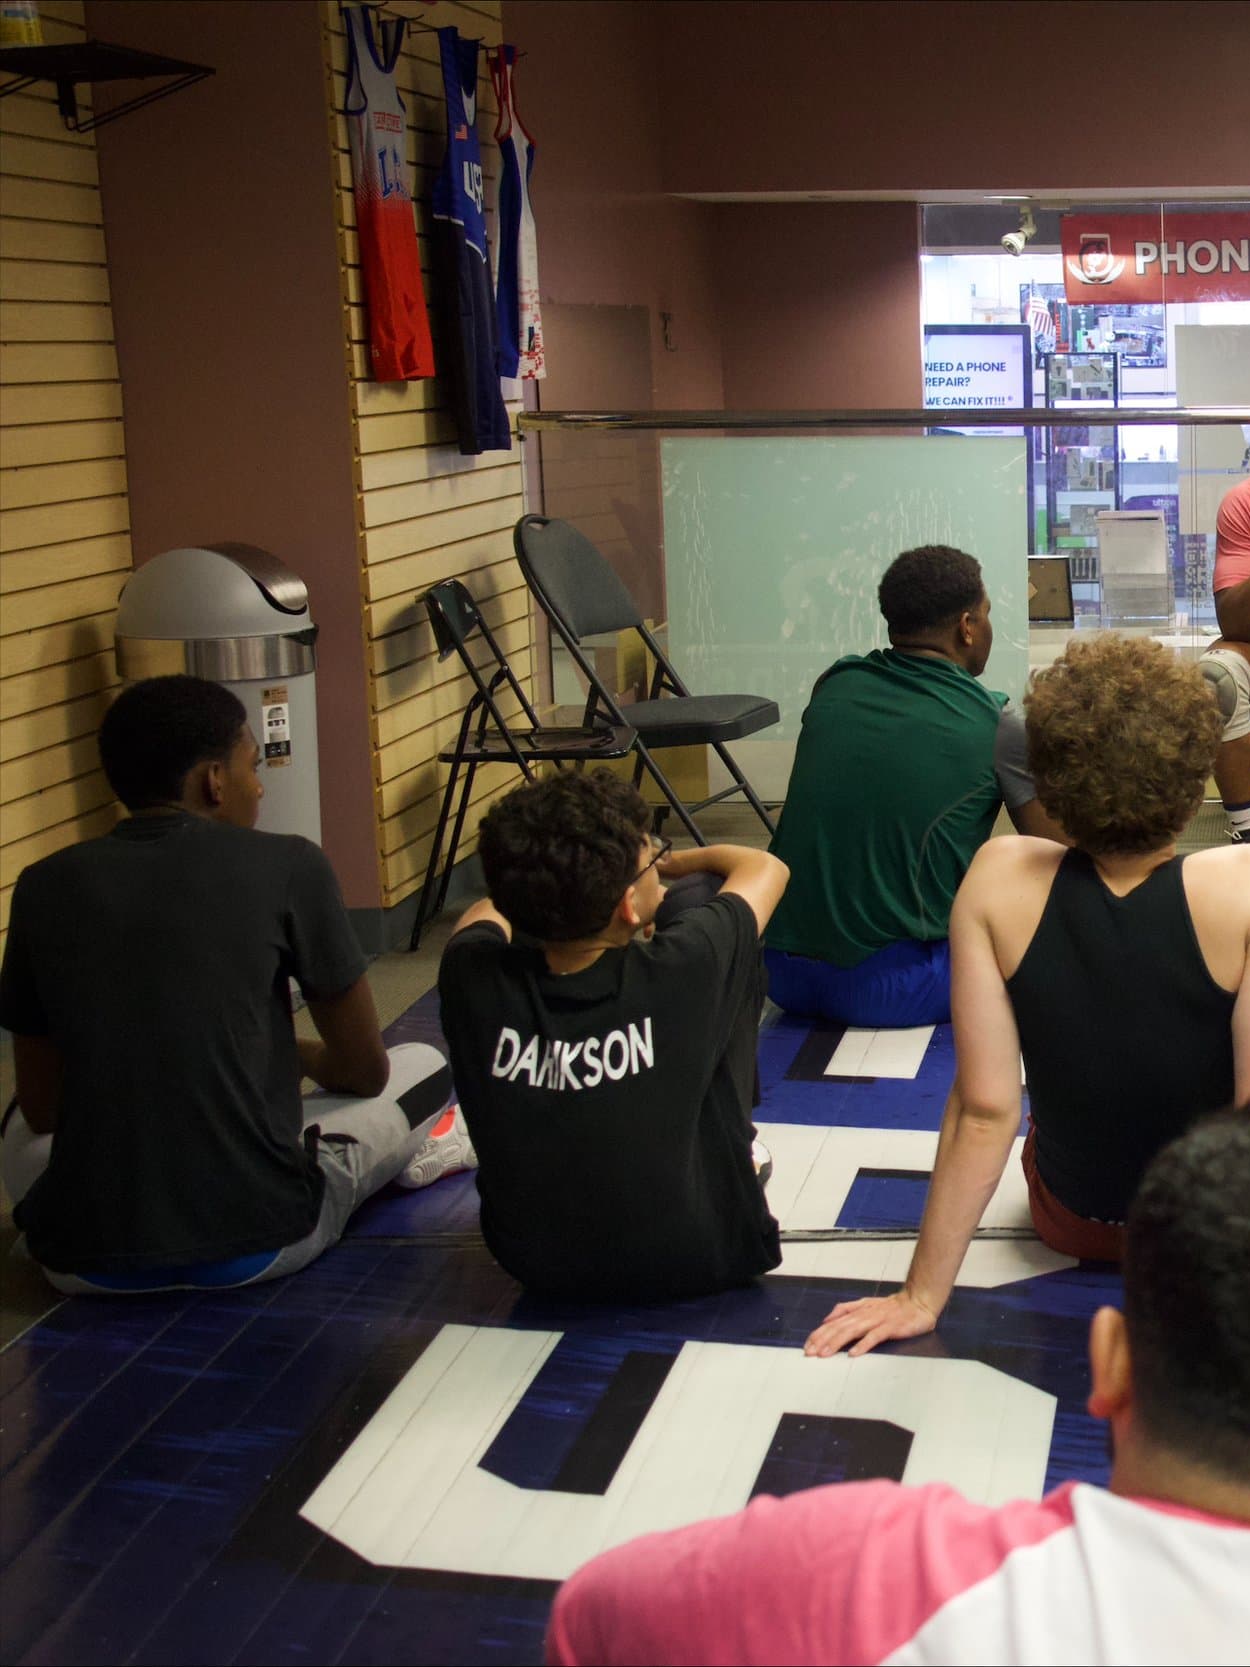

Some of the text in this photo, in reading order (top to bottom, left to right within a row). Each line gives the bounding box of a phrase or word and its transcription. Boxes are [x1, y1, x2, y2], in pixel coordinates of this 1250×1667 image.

[924, 361, 1007, 372] NEED A PHONE
[924, 376, 971, 387] REPAIR?
[942, 396, 966, 406] CAN
[968, 396, 984, 406] FIX
[985, 396, 1006, 406] IT!!!
